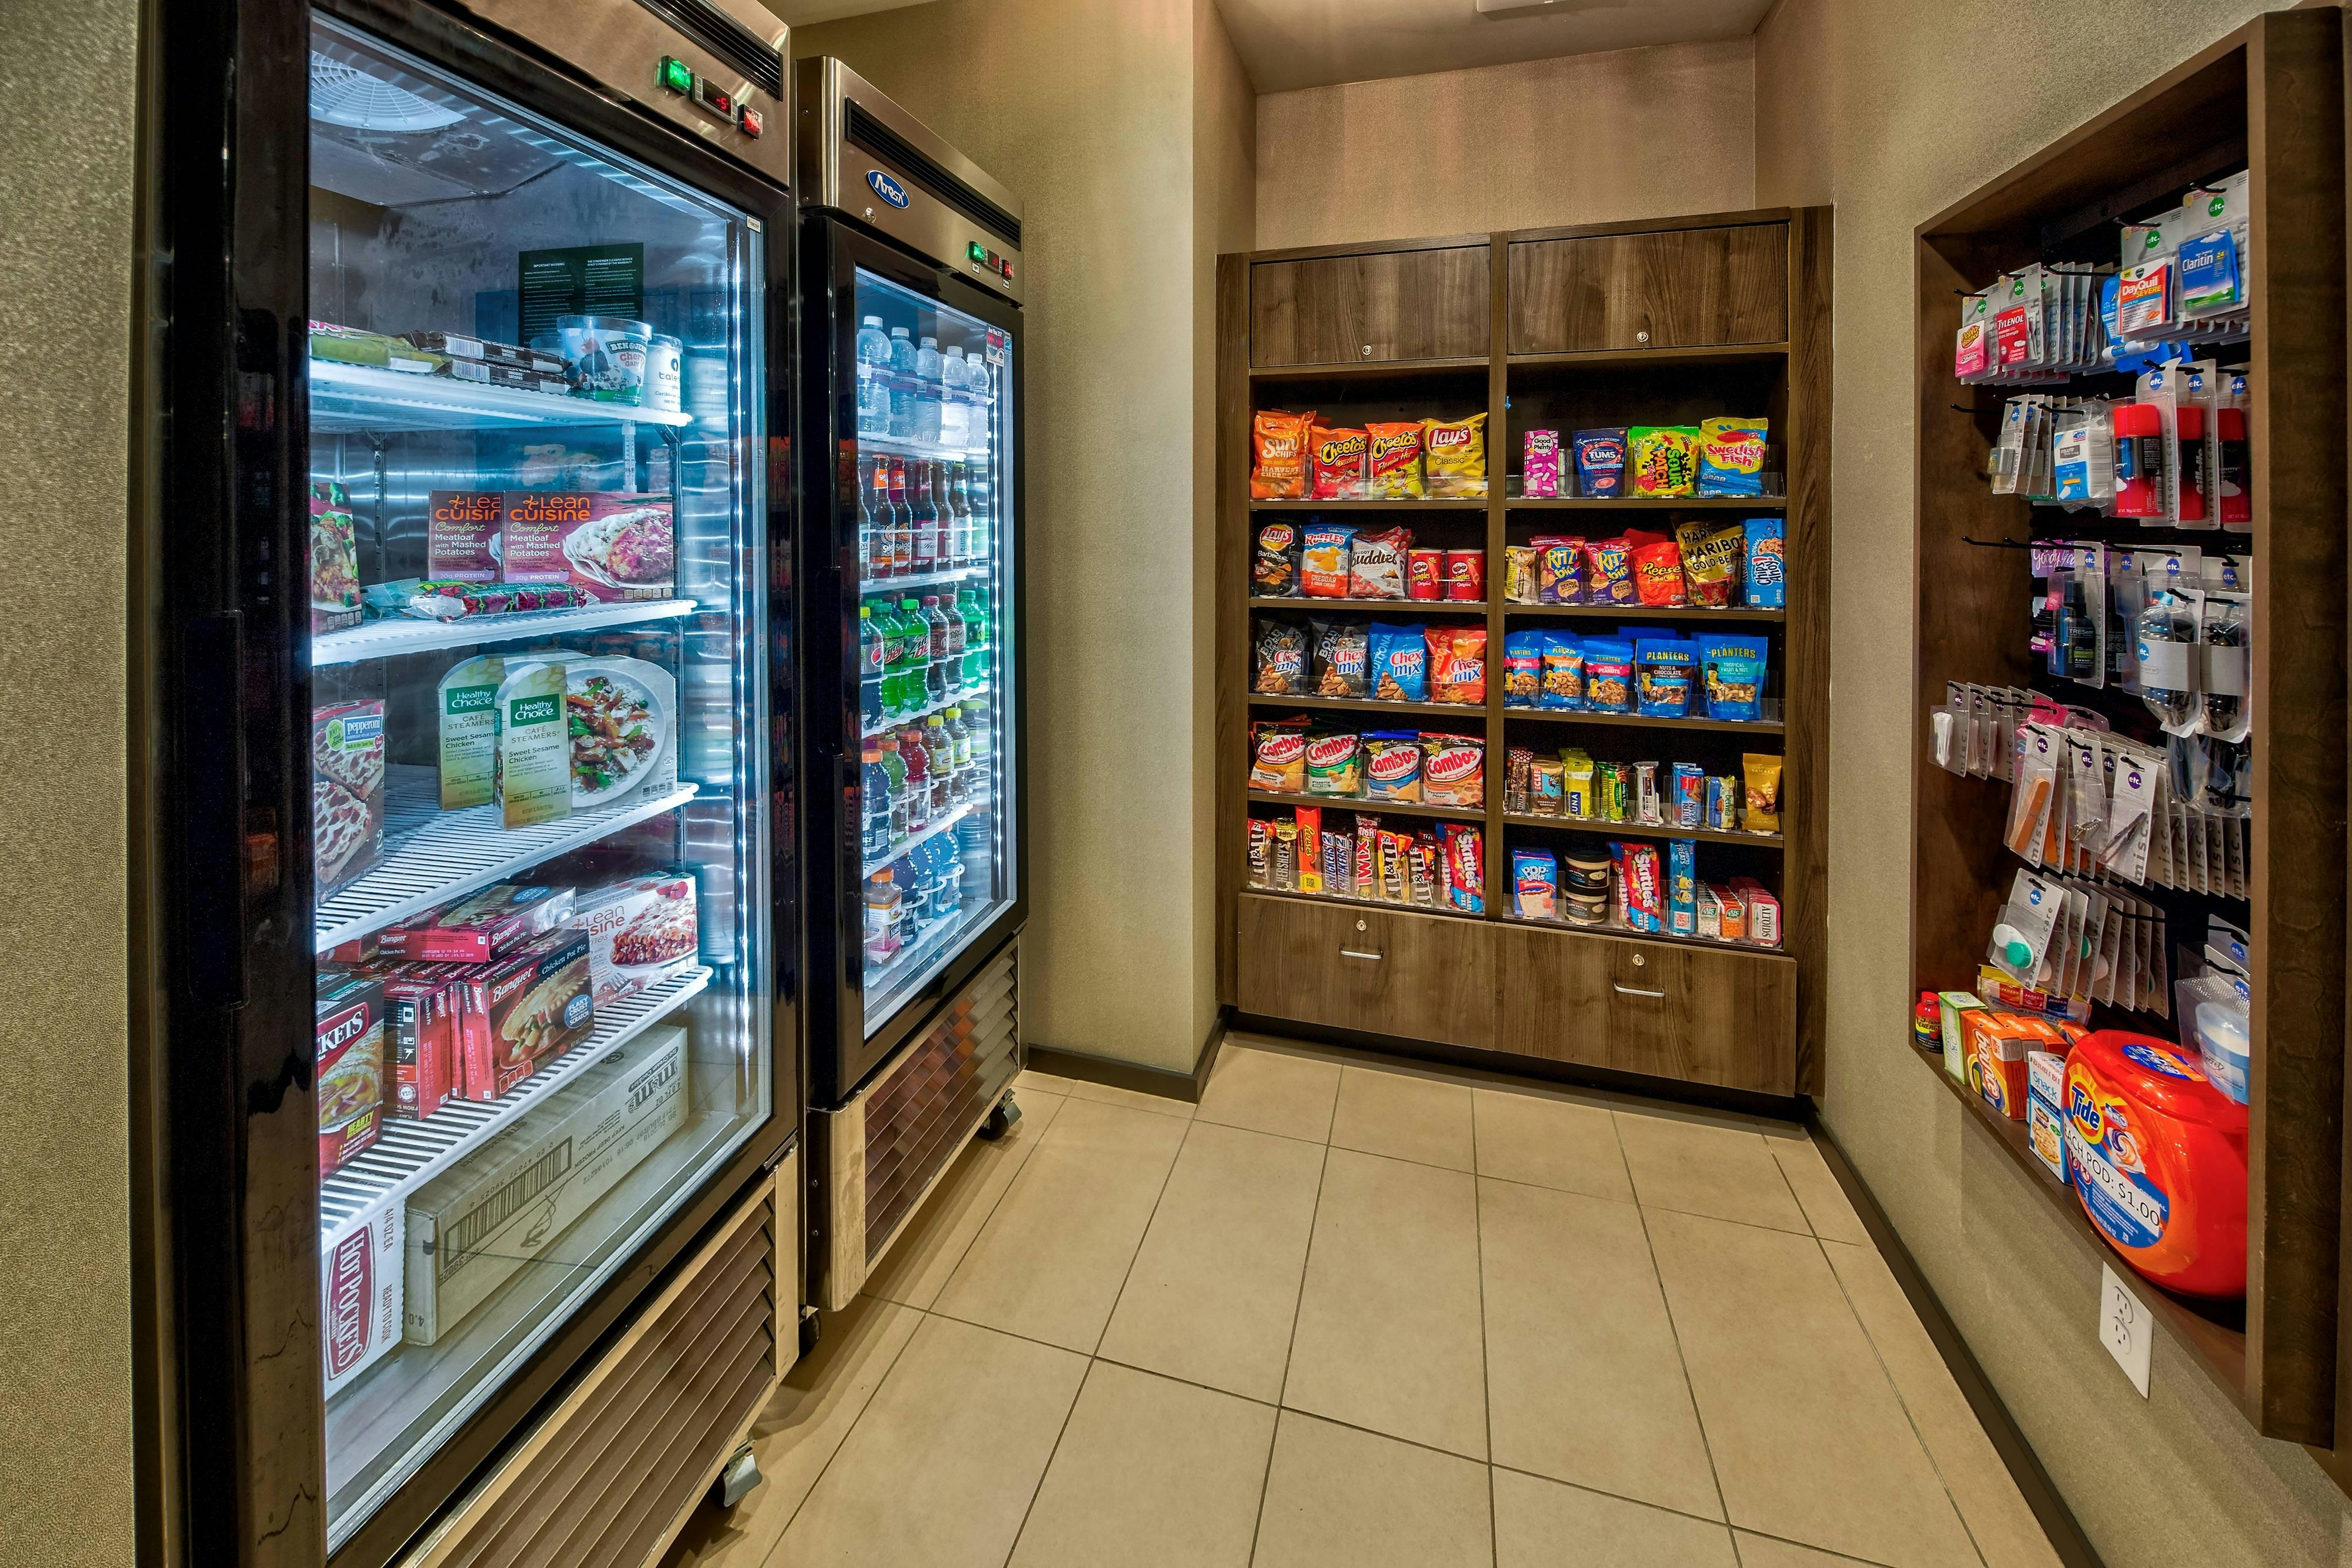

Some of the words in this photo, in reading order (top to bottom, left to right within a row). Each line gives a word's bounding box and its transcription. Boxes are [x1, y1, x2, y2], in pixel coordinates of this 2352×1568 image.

[2182, 255, 2213, 272] Claritin
[2122, 275, 2159, 296] DayQuil
[2136, 285, 2162, 297] SEVERE
[1997, 315, 2024, 330] TYLENOL
[1963, 333, 1979, 347] Bismol
[1372, 432, 1418, 460] Cheetos
[1431, 429, 1469, 447] Lay's
[1275, 450, 1297, 459] CHIPS
[1321, 436, 1367, 464] Cheetos
[1589, 451, 1616, 459] TUMS
[1706, 443, 1765, 459] Swedish
[1335, 455, 1358, 467] Crunchy
[1435, 457, 1465, 466] Classic
[1667, 449, 1682, 486] SOUR
[1719, 453, 1754, 467] Fish
[1652, 449, 1669, 489] PATCH
[2196, 448, 2204, 495] Gillette
[2166, 464, 2175, 523] personal
[2207, 467, 2216, 526] personal
[540, 497, 591, 509] Lean
[435, 522, 486, 534] Comfort
[510, 522, 560, 534] Comfort
[1261, 528, 1291, 543] Lay's
[1305, 533, 1345, 546] RUFFLES
[1258, 550, 1288, 561] Barbecue
[1687, 537, 1740, 559] HARIBO
[1546, 550, 1577, 569] RITZ
[1598, 551, 1628, 571] RITZ
[1311, 574, 1337, 583] CHEDDAR
[1412, 573, 1430, 584] Pringles
[1275, 649, 1302, 663] Chex
[1334, 648, 1367, 663] Chex
[1390, 649, 1424, 666] Chex
[1646, 651, 1689, 662] PLANTERS
[1712, 647, 1756, 658] PLANTERS
[1277, 658, 1302, 671] mix
[1337, 660, 1364, 675] mix
[1394, 661, 1423, 677] mix
[1450, 658, 1484, 673] Chex
[1454, 666, 1482, 683] mix
[452, 697, 493, 708] Choice
[457, 690, 491, 700] Healthy
[515, 708, 554, 720] Choice
[520, 701, 553, 711] Healthy
[347, 717, 380, 734] pepperoni
[448, 719, 495, 730] STEAMERS
[462, 713, 485, 722] CAFÉ
[524, 725, 547, 734] CAFÉ
[446, 741, 475, 749] Chicken
[509, 749, 530, 757] Sweet
[532, 744, 560, 753] Sesame
[1260, 735, 1305, 756] Combos
[1308, 735, 1355, 760] Combos
[509, 754, 537, 764] Chicken
[1369, 749, 1418, 773] Combos
[1428, 750, 1477, 774] Combos
[2129, 777, 2141, 785] etc.
[1304, 824, 1315, 857] Reese's
[2031, 813, 2045, 862] misc.
[1276, 843, 1289, 882] HERSHEY'S
[1457, 834, 1477, 888] Skittles
[1674, 844, 1685, 865] TREATS
[1324, 847, 1337, 890] SNICKERS
[1355, 839, 1373, 891] TWIX
[2228, 833, 2241, 897] misc.
[1634, 853, 1652, 908] Skittles
[586, 905, 624, 927] Lean
[380, 935, 407, 944] Banquet
[492, 920, 522, 945] Banquet
[542, 957, 565, 974] Chicken
[566, 950, 576, 959] Pot
[577, 944, 586, 954] Pie
[493, 967, 534, 1003] Banquet
[569, 996, 589, 1011] FLAKY
[569, 1004, 589, 1017] CRUST
[2005, 1004, 2024, 1012] YOUR
[2025, 1008, 2040, 1017] LEVEL
[2033, 1071, 2057, 1099] Snack
[2034, 1089, 2045, 1102] TUNA
[2045, 1099, 2057, 1114] SALAD
[2072, 1085, 2100, 1130] Tide
[2064, 1123, 2084, 1154] EACH
[2087, 1152, 2114, 1189] POD:
[2119, 1182, 2160, 1226] $1.00
[383, 1223, 394, 1236] OZ
[383, 1236, 393, 1252] EA
[382, 1284, 393, 1312] READY
[382, 1311, 392, 1322] TO
[381, 1322, 392, 1344] COOK
